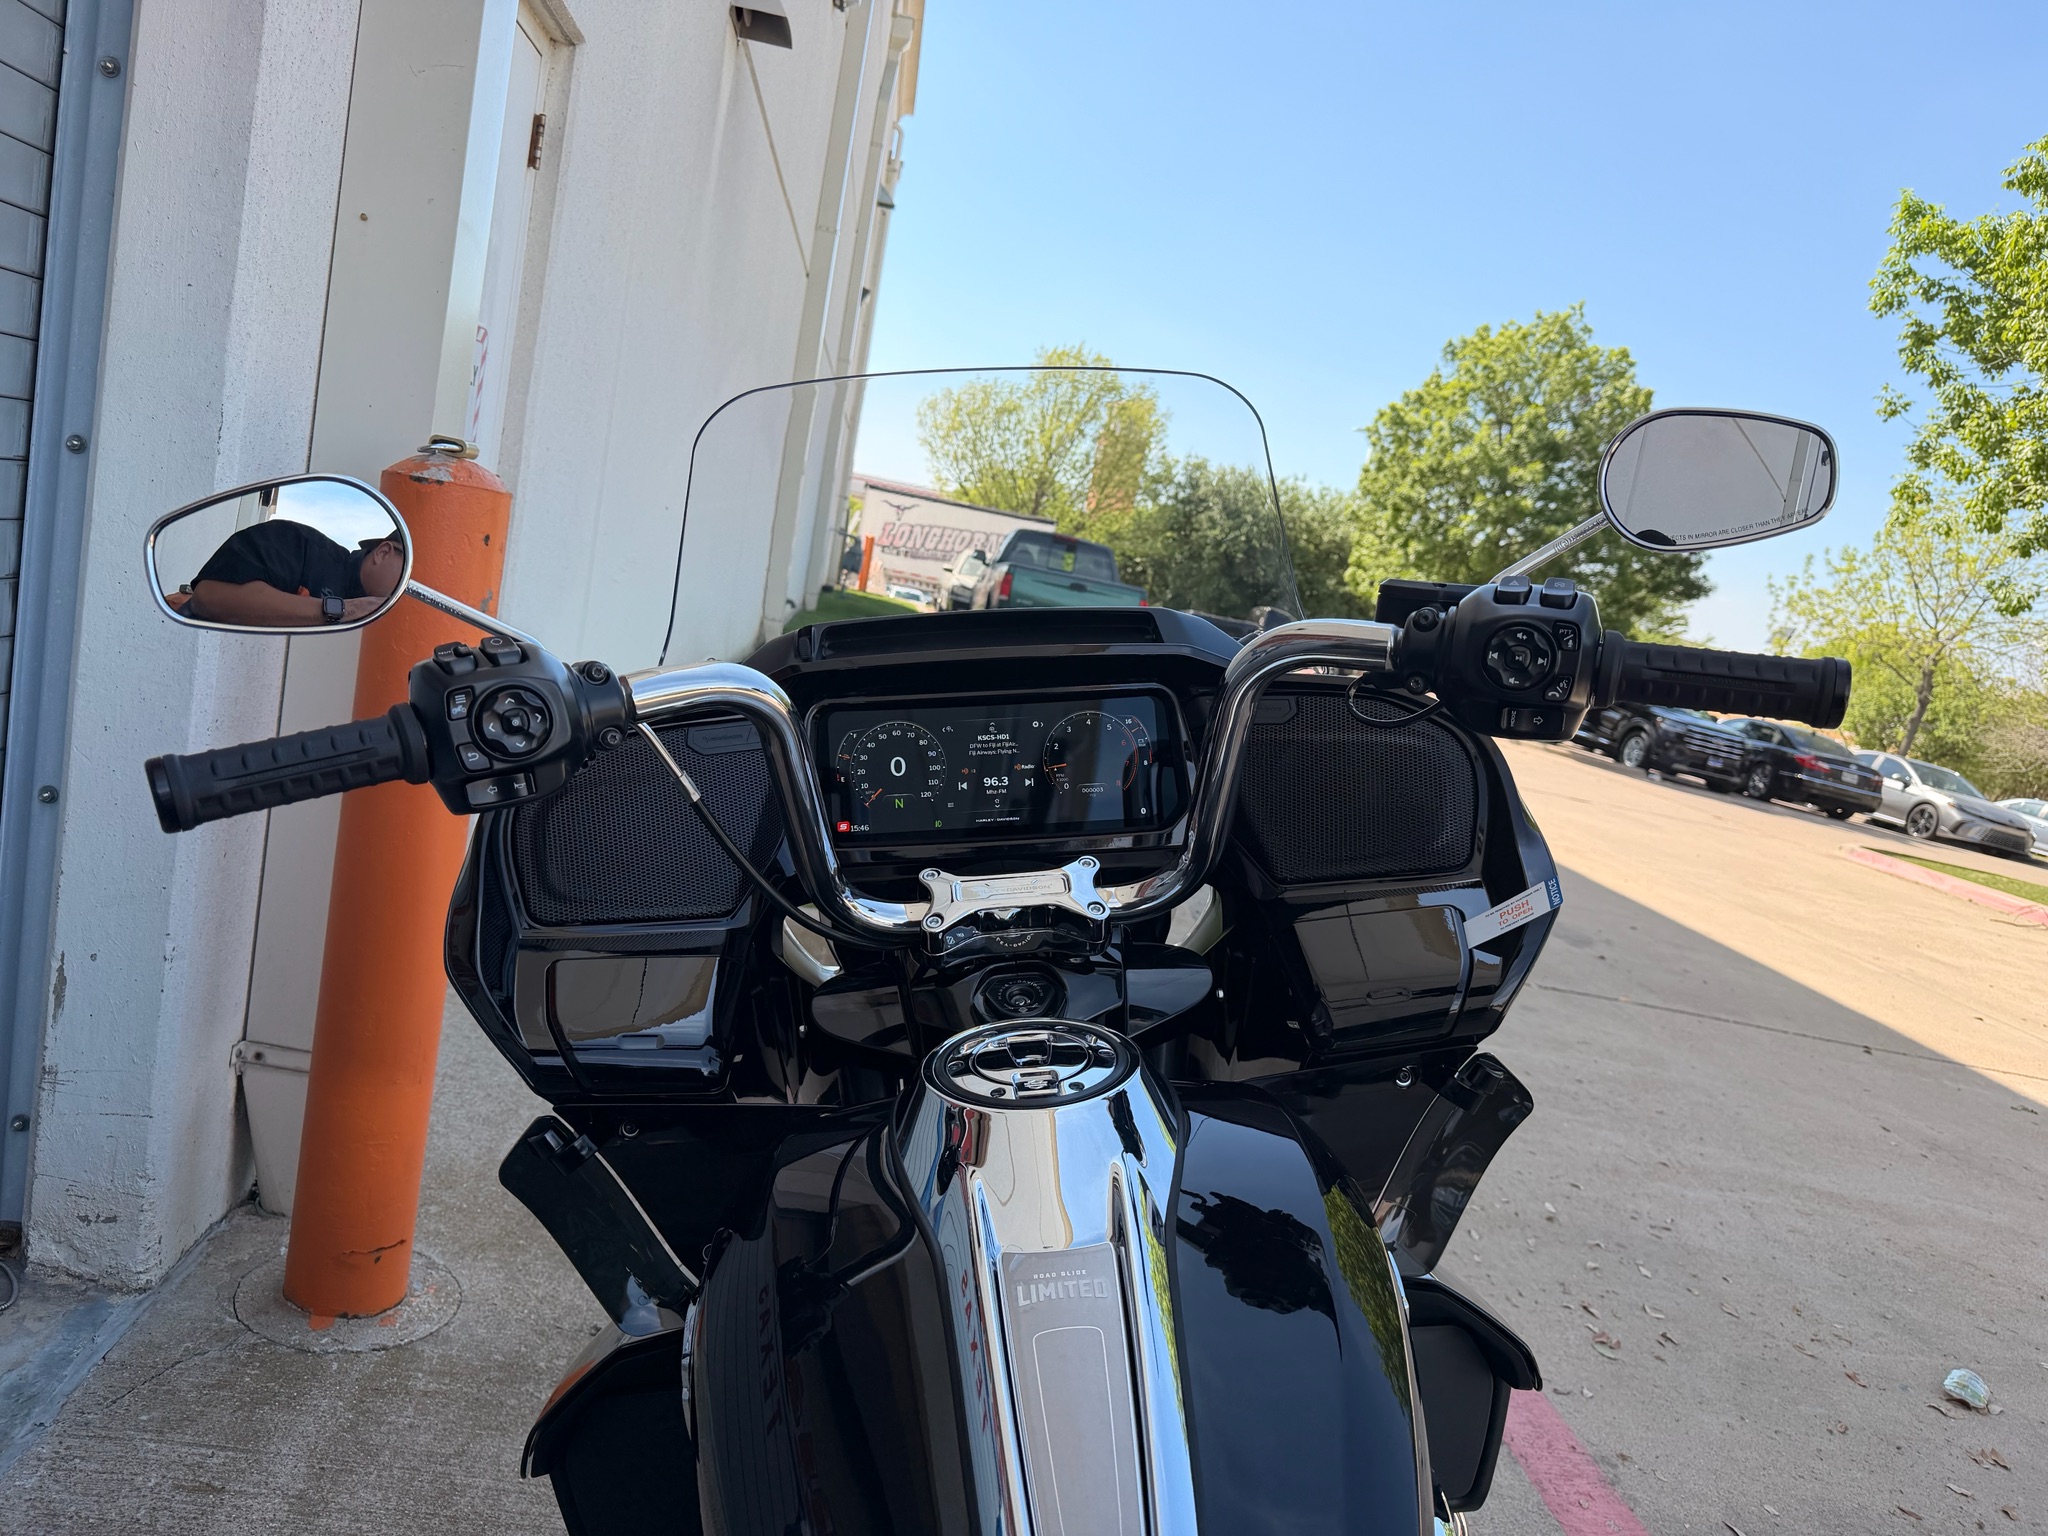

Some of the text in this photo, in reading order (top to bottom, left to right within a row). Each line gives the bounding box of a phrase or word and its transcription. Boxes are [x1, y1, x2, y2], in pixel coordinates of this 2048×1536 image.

[1694, 530, 1718, 538] MIRROR
[1730, 524, 1754, 534] CLOSER
[1755, 520, 1770, 528] THAN
[1771, 515, 1786, 524] THEY
[890, 756, 906, 776] 0
[984, 776, 1009, 786] 96.3
[895, 798, 904, 808] N
[1548, 878, 1560, 906] NOTICE
[1498, 906, 1533, 926] TO OPEN
[1499, 900, 1529, 919] PUSH
[1016, 1278, 1108, 1306] LIMITED
